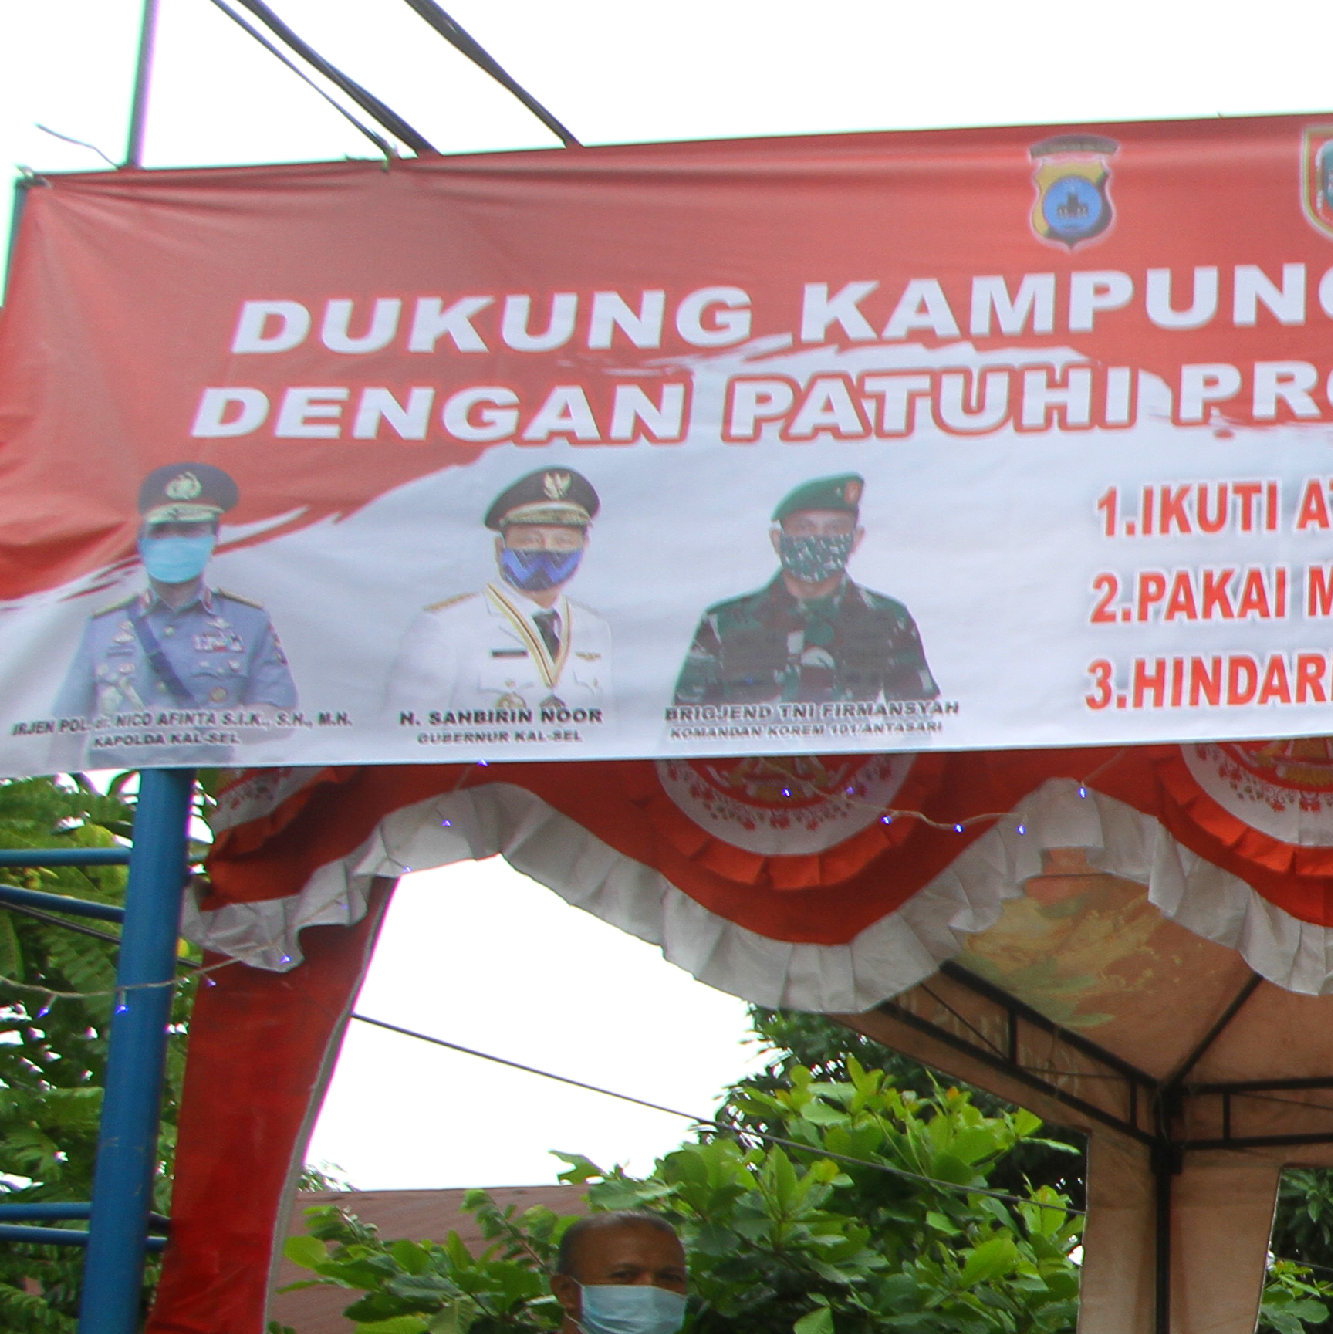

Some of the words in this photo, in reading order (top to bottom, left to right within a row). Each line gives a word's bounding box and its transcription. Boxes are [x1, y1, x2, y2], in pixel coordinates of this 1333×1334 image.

[232, 286, 754, 355] DUKUNG
[191, 382, 690, 442] DENGAN
[730, 364, 1134, 437] PATUHI
[1097, 482, 1278, 537] 1.IKUTI
[1091, 567, 1287, 622] 2.PAKAI
[116, 713, 151, 728] NICO
[159, 711, 216, 727] AFINTA
[400, 711, 421, 725] H.
[429, 709, 531, 725] SAHBIRIN
[540, 708, 603, 724] NOOR
[665, 704, 772, 722] BRIGJEND
[779, 704, 816, 720] TNI
[822, 701, 960, 717] FIRMANSYAH
[95, 735, 166, 748] KAPOLDA
[417, 731, 509, 745] GUBERNUR
[515, 729, 583, 743] KAL-SEL
[670, 726, 763, 740] KOMANDAN
[767, 724, 825, 738] KOREM
